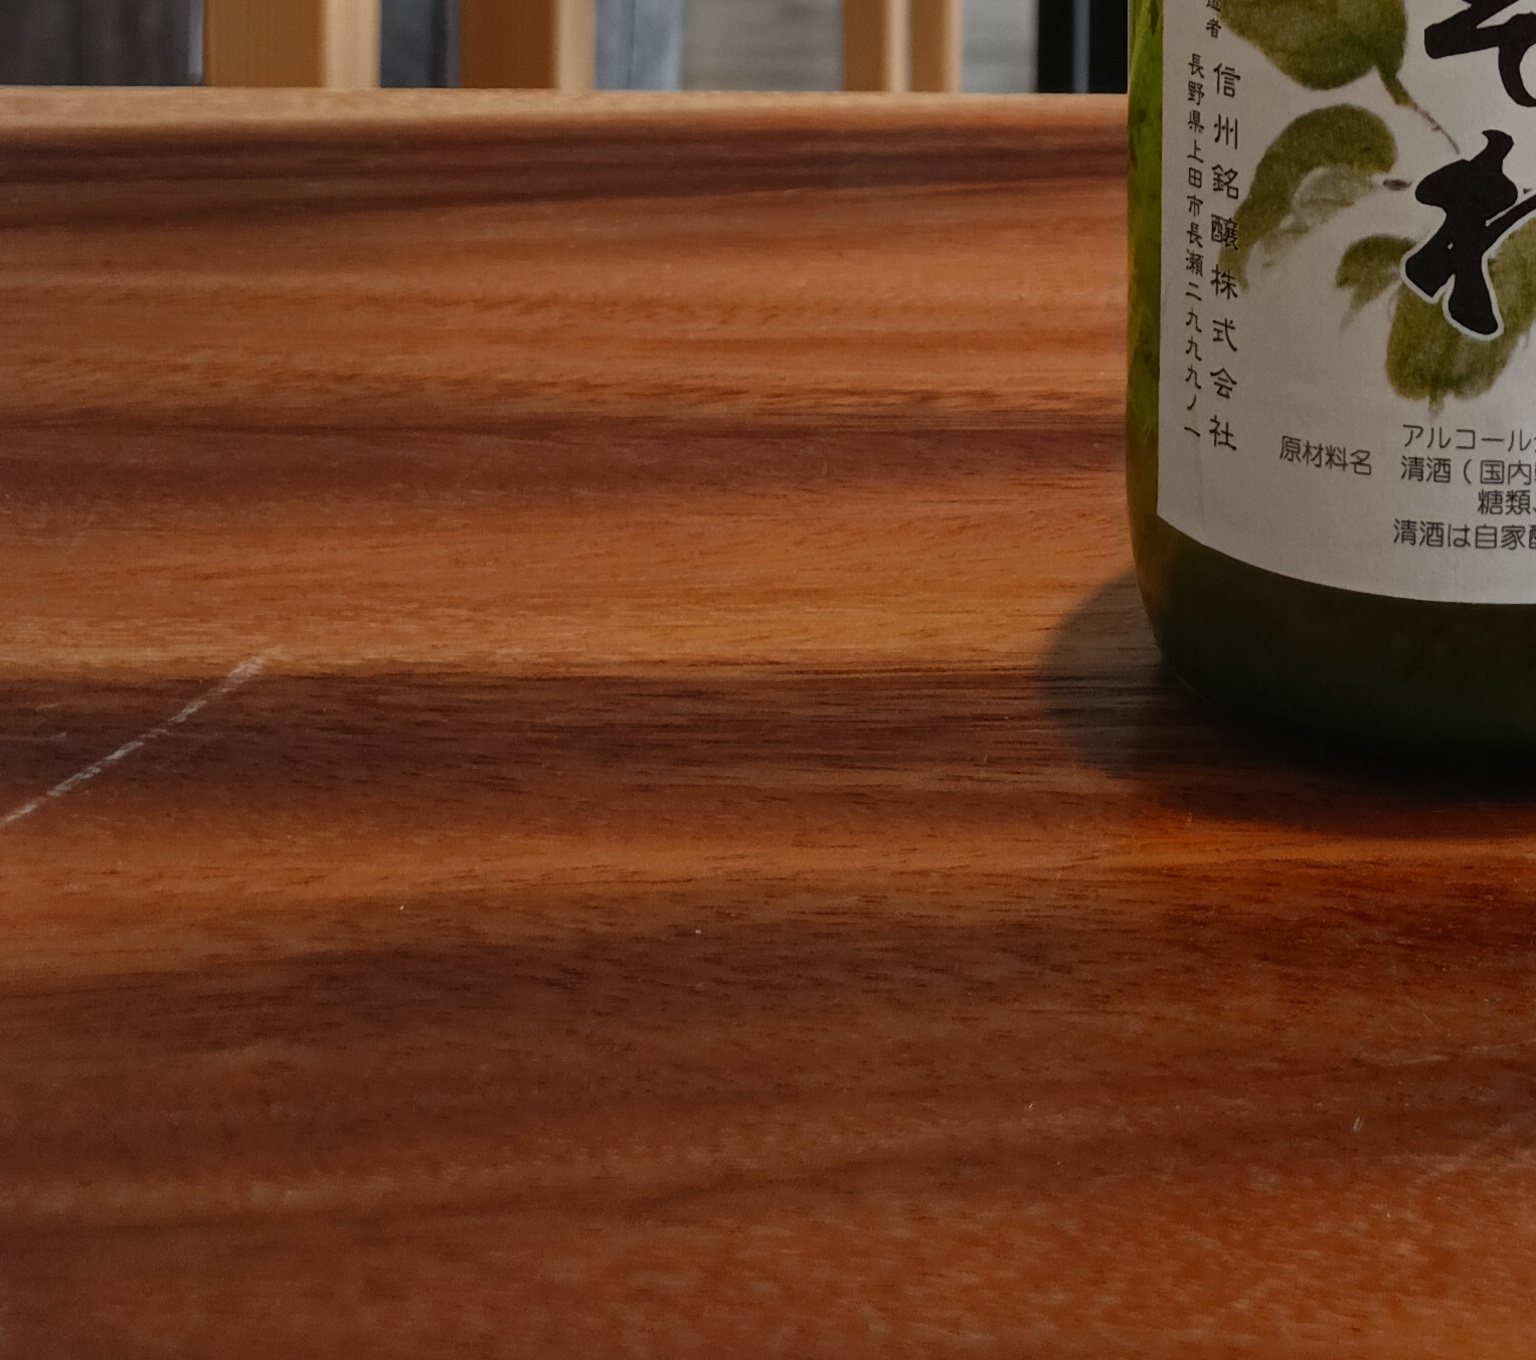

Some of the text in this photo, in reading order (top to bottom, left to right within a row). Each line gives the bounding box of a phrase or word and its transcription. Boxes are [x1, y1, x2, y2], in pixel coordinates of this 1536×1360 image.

[1208, 62, 1241, 452] 信州銘醸株式会社
[1279, 435, 1373, 476] 原材料名
